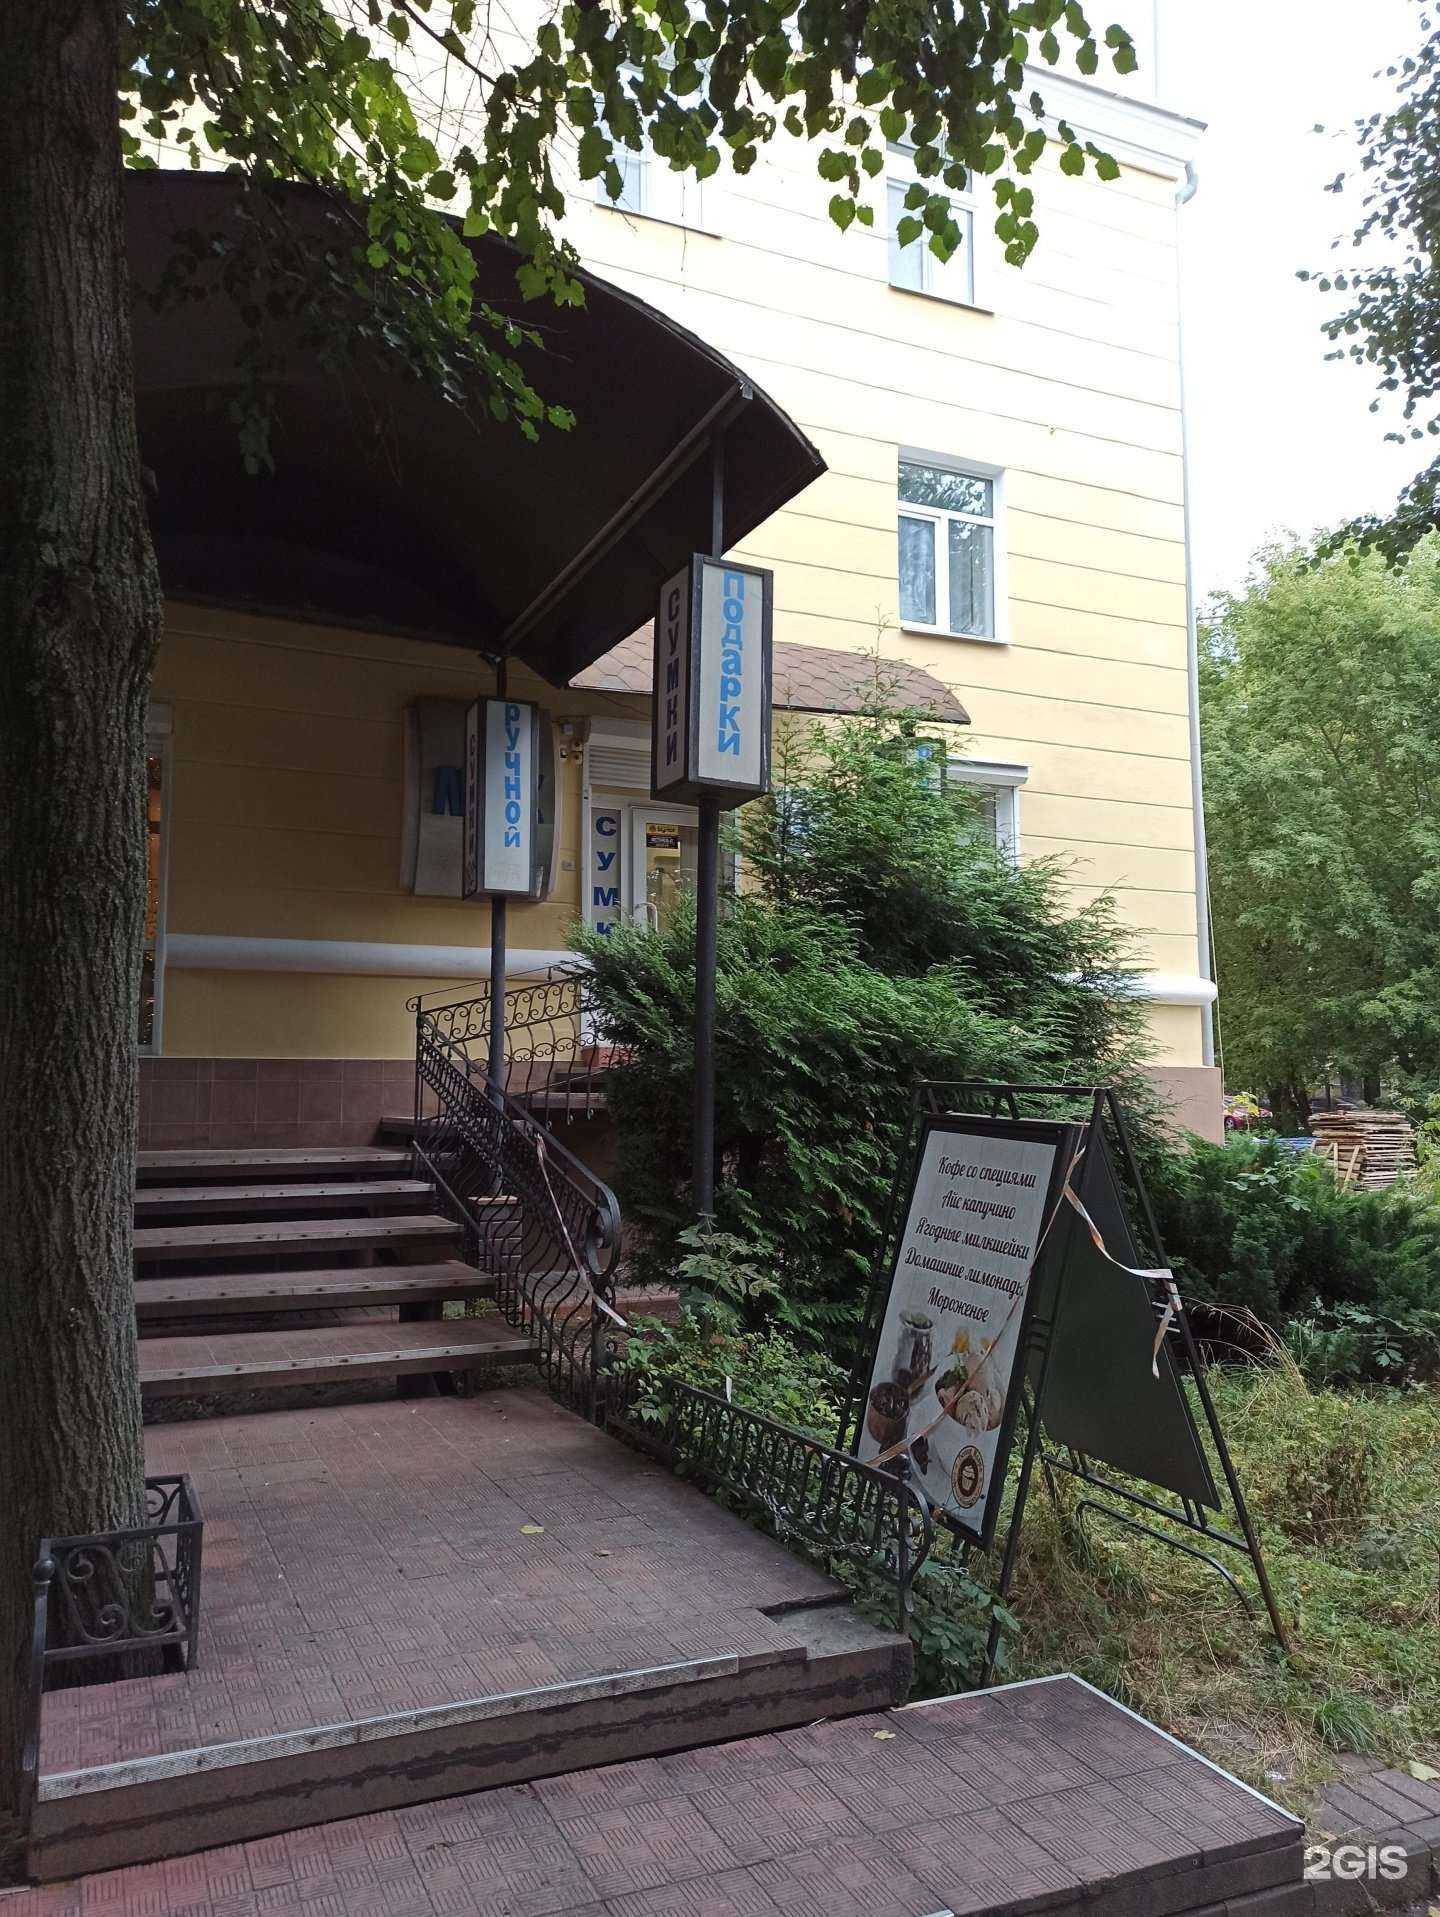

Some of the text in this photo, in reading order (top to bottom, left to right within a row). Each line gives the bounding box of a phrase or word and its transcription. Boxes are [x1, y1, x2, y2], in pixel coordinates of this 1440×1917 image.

[665, 587, 680, 766] СУМКИ
[938, 1155, 1037, 1188] Кофе со специями
[942, 1189, 1017, 1220] Айс капучино
[915, 1216, 1030, 1260] Ягодные милкшейки
[904, 1246, 965, 1279] Домашние
[927, 1286, 990, 1323] Мороженое
